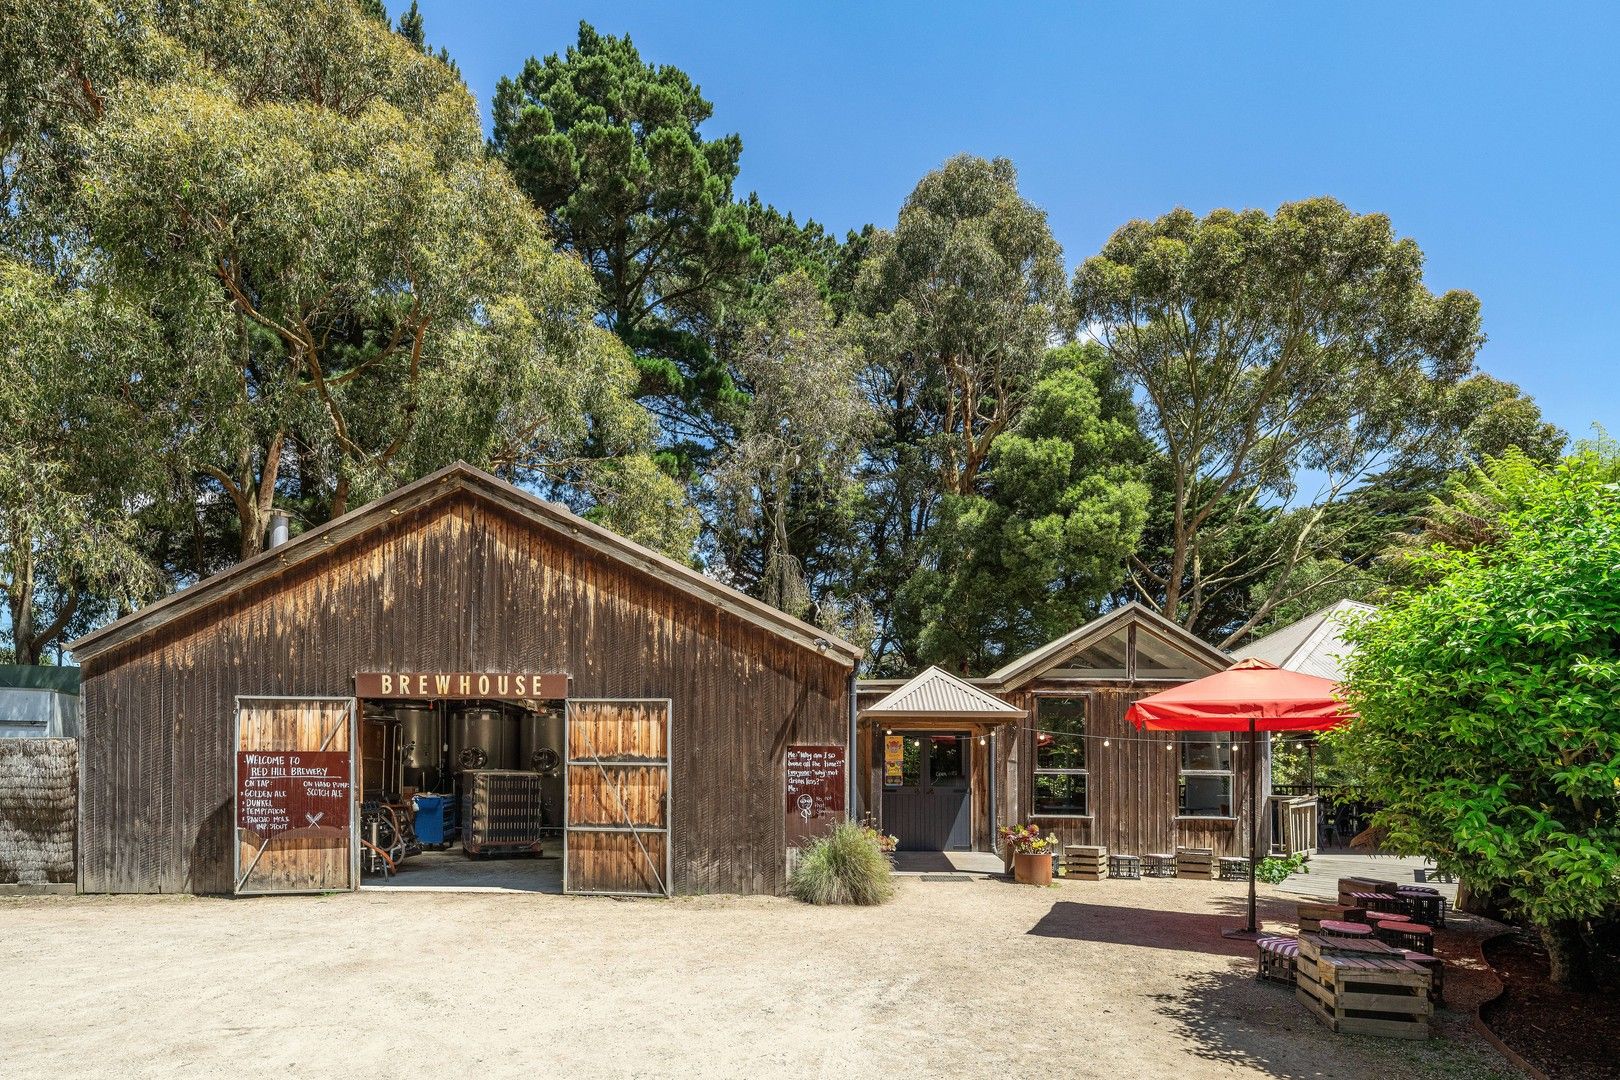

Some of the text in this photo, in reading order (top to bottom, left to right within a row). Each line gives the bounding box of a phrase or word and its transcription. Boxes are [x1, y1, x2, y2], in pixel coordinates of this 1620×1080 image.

[381, 675, 541, 695] BREWHOUSE
[245, 754, 300, 765] WELCOME TO
[251, 767, 328, 776] RED HILL BREWERY
[244, 779, 255, 787] ON
[302, 780, 313, 788] ON
[244, 789, 287, 798] GOLDEN ALE
[306, 787, 343, 798] SCOTCH ALE
[246, 799, 272, 807] DUNKEL
[246, 807, 286, 815] TEMPTATION
